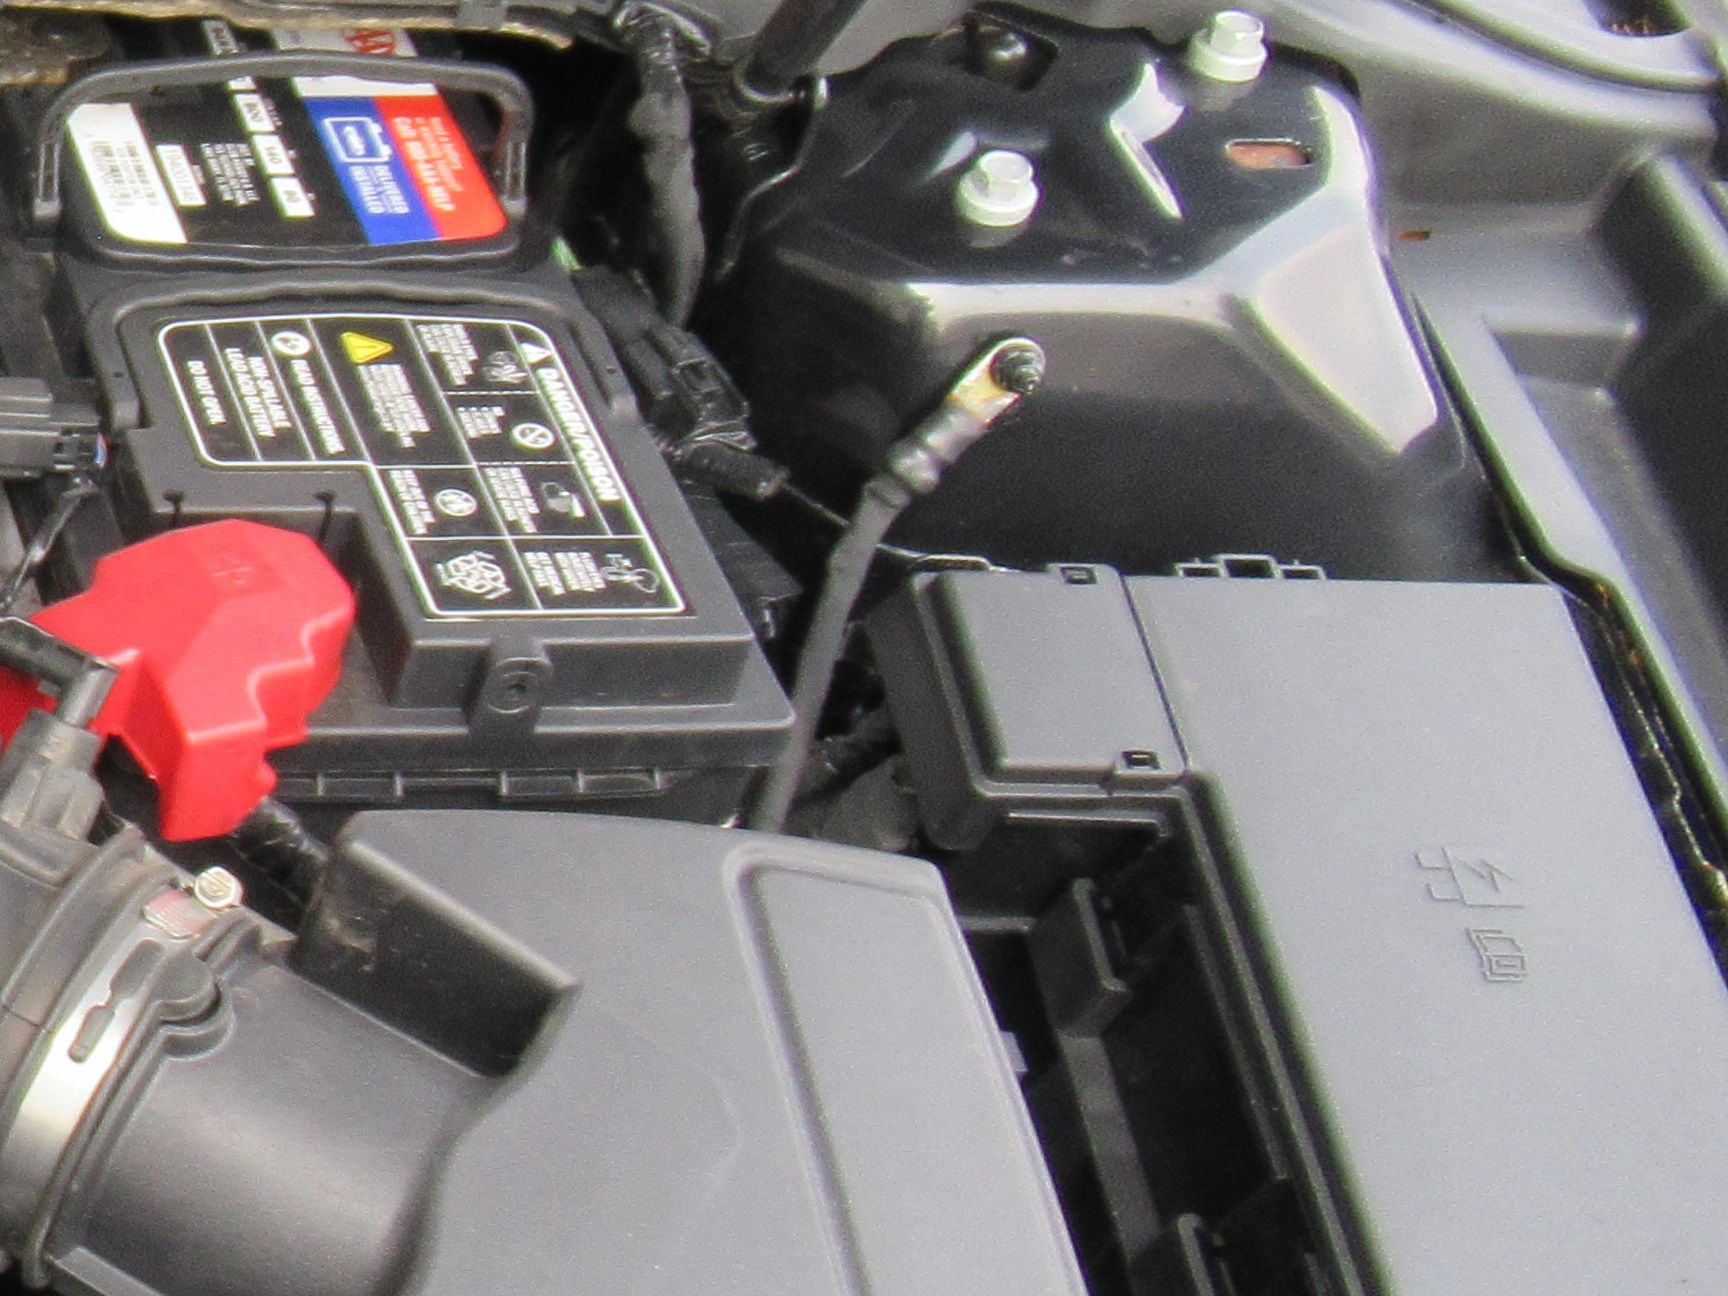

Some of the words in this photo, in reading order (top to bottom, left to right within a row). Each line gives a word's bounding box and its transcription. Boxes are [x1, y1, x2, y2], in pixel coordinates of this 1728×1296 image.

[348, 164, 385, 214] INSTALLED
[373, 164, 411, 214] DELIVERED
[187, 359, 208, 375] DO
[224, 347, 248, 373] LEAD
[290, 359, 316, 386] READ
[194, 376, 217, 396] NOT
[236, 373, 258, 396] ACID
[246, 356, 293, 429] NON-SPILLABLE
[244, 396, 277, 438] BATTERY
[536, 368, 622, 501] DANGER/POISON
